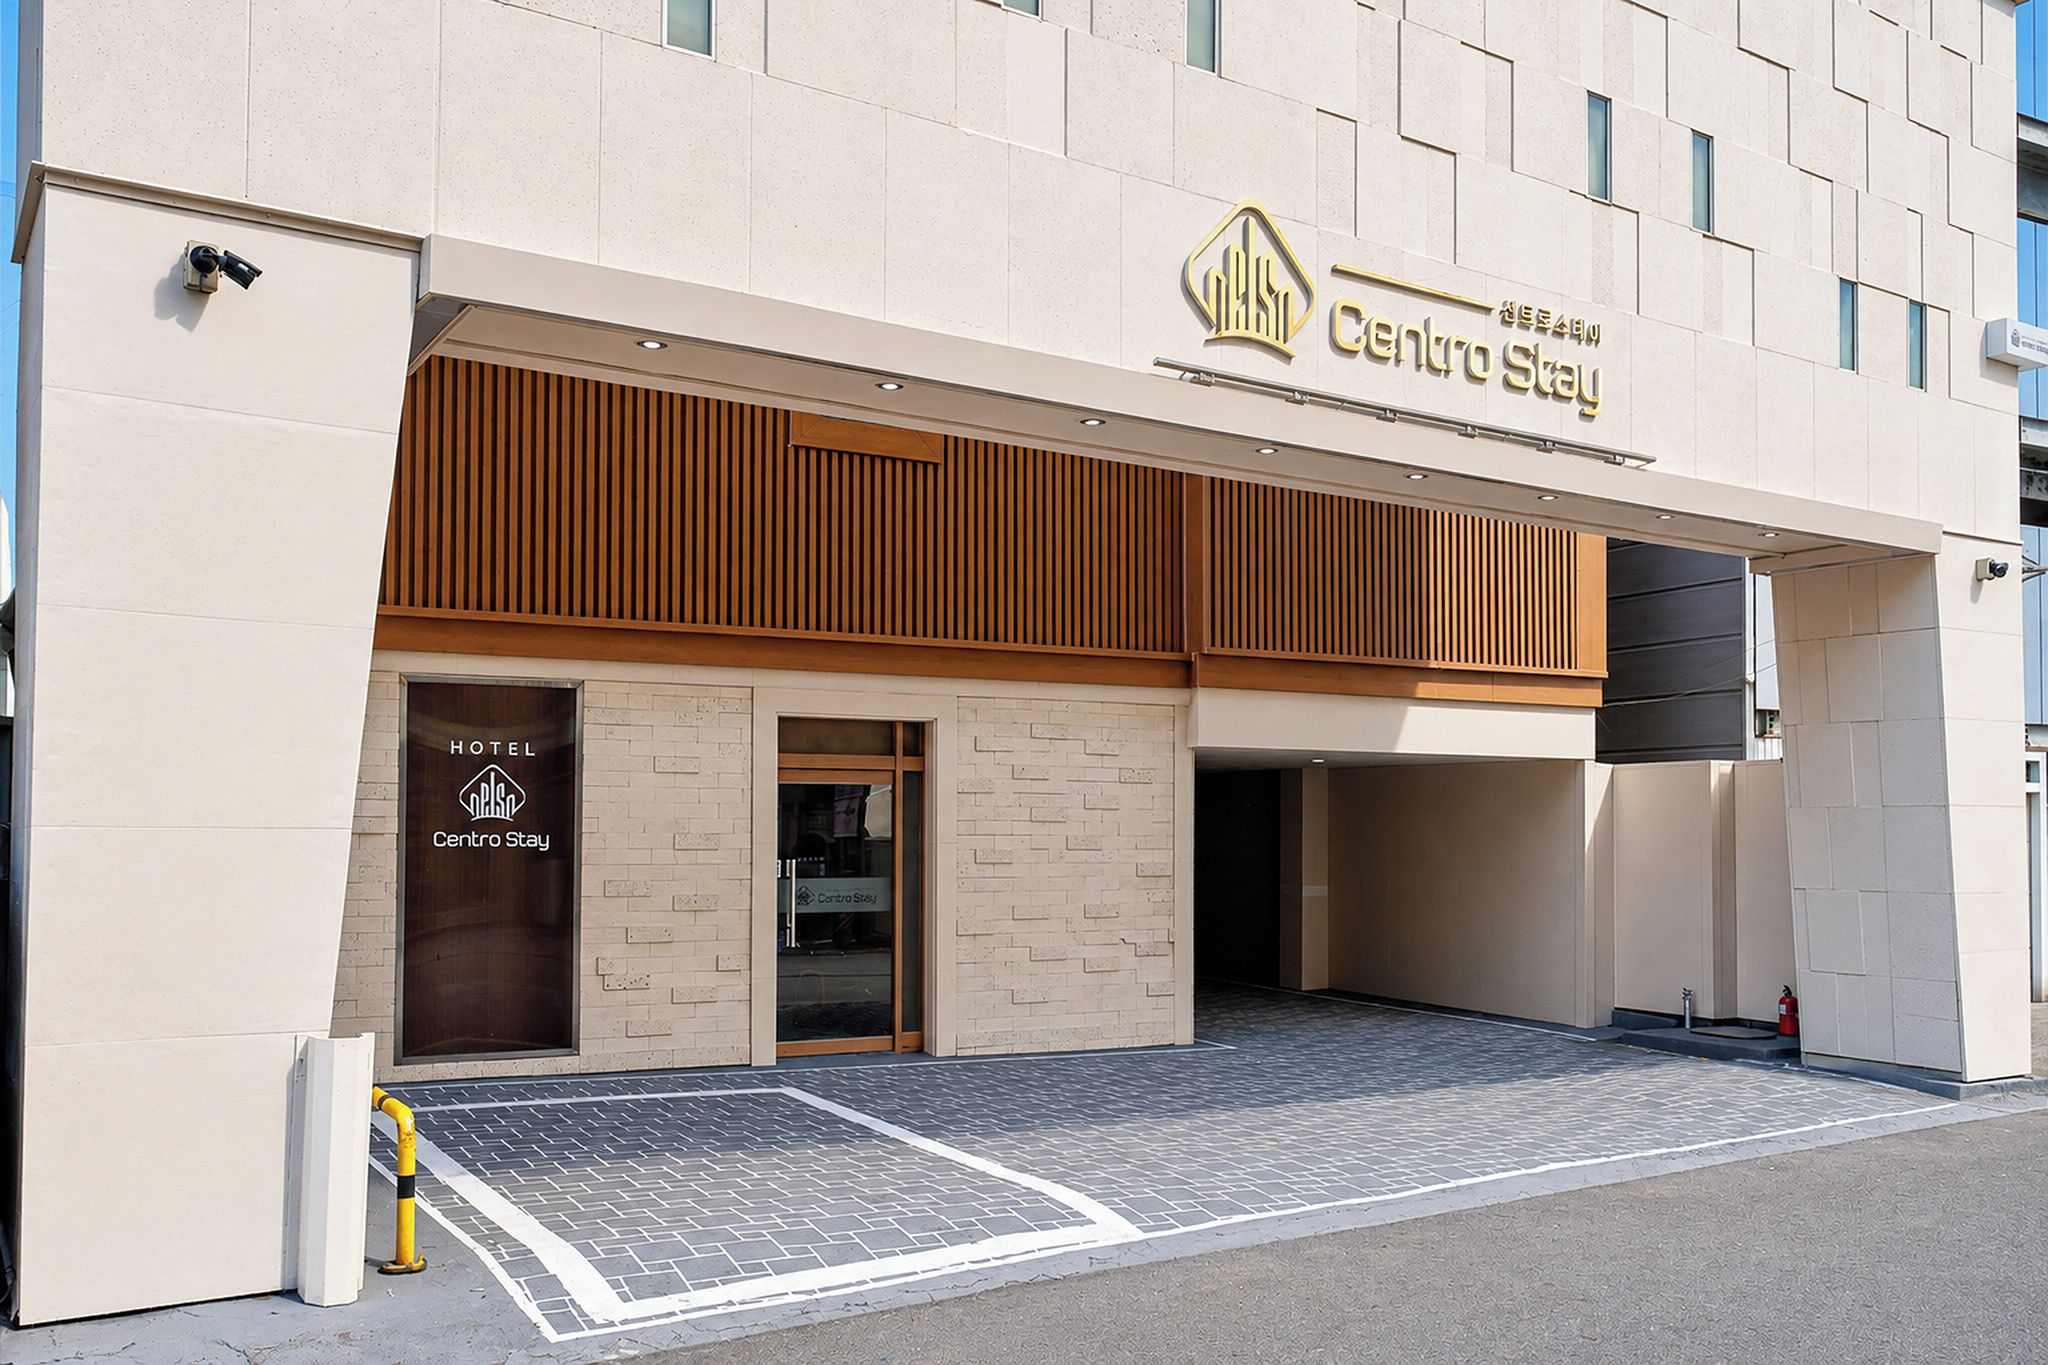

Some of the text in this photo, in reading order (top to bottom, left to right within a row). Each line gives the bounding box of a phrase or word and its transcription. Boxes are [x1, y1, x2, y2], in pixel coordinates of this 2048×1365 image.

[1499, 299, 1600, 344] 센트로스테이
[1330, 297, 1601, 417] Centro Stay
[450, 740, 535, 756] HOTEL
[433, 831, 550, 851] Centro Stay
